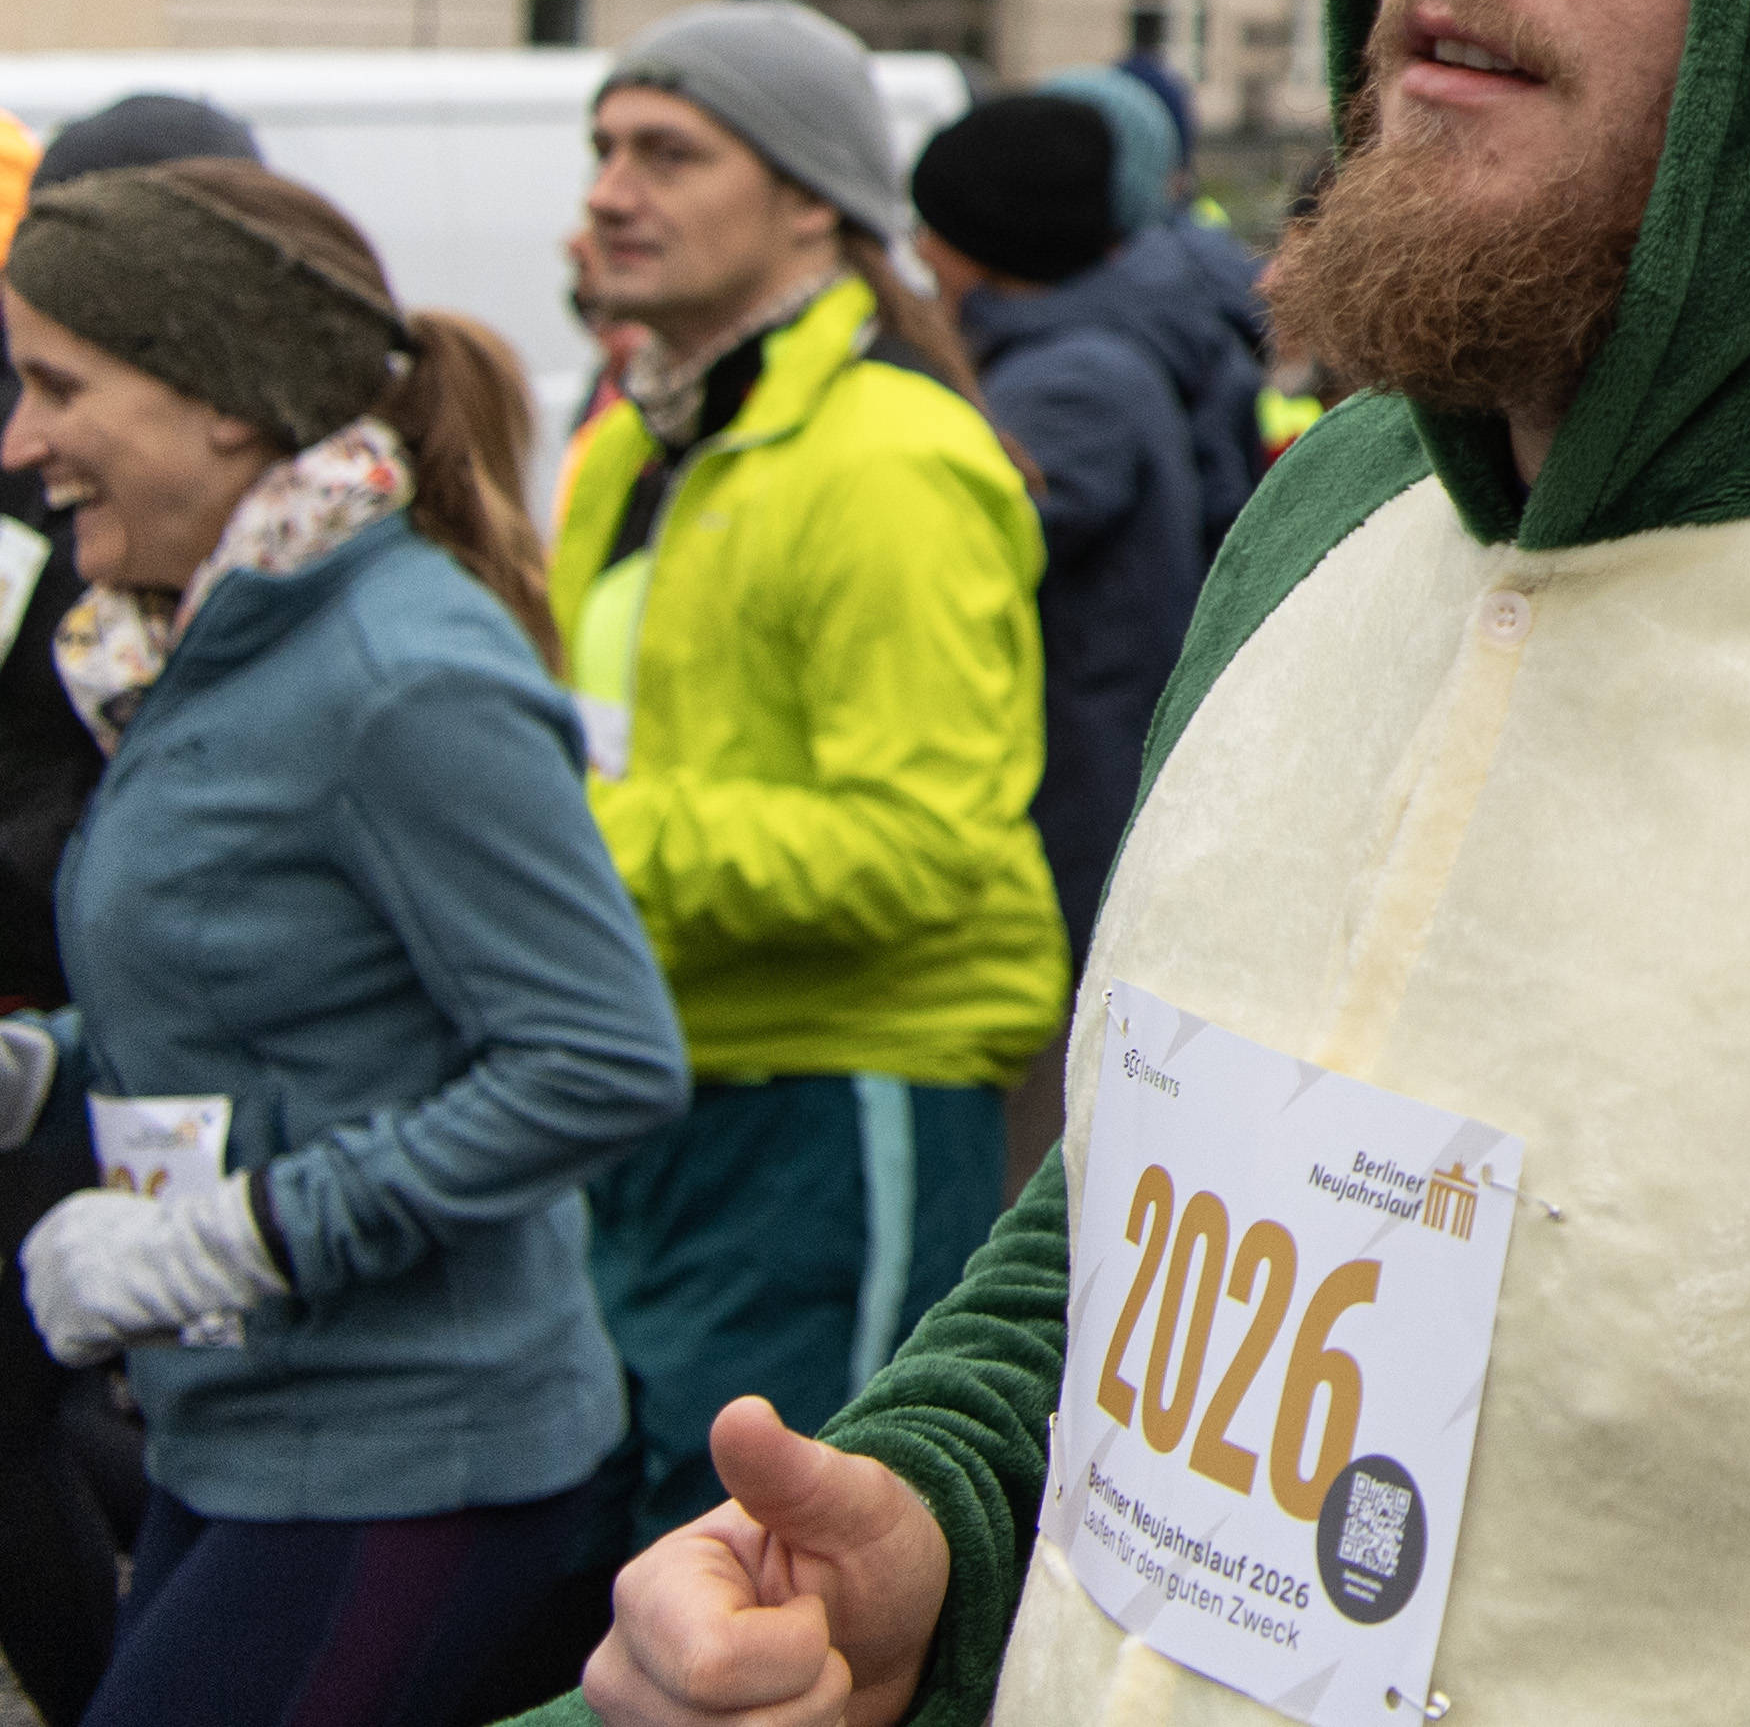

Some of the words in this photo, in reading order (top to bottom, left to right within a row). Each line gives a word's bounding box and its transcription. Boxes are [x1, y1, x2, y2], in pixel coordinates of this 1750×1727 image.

[1308, 1162, 1425, 1222] Neujahrslauf
[1352, 1150, 1426, 1195] Berliner
[1097, 1163, 1383, 1522] 2026
[1084, 1509, 1116, 1552] Laufen
[1117, 1529, 1136, 1563] für
[1136, 1549, 1164, 1588] den
[1166, 1572, 1224, 1617] guten
[1228, 1595, 1301, 1650] Zweck
[1088, 1461, 1130, 1518] Berliner
[1130, 1499, 1248, 1583] Neujahrslauf
[1249, 1562, 1311, 1611] 2026
